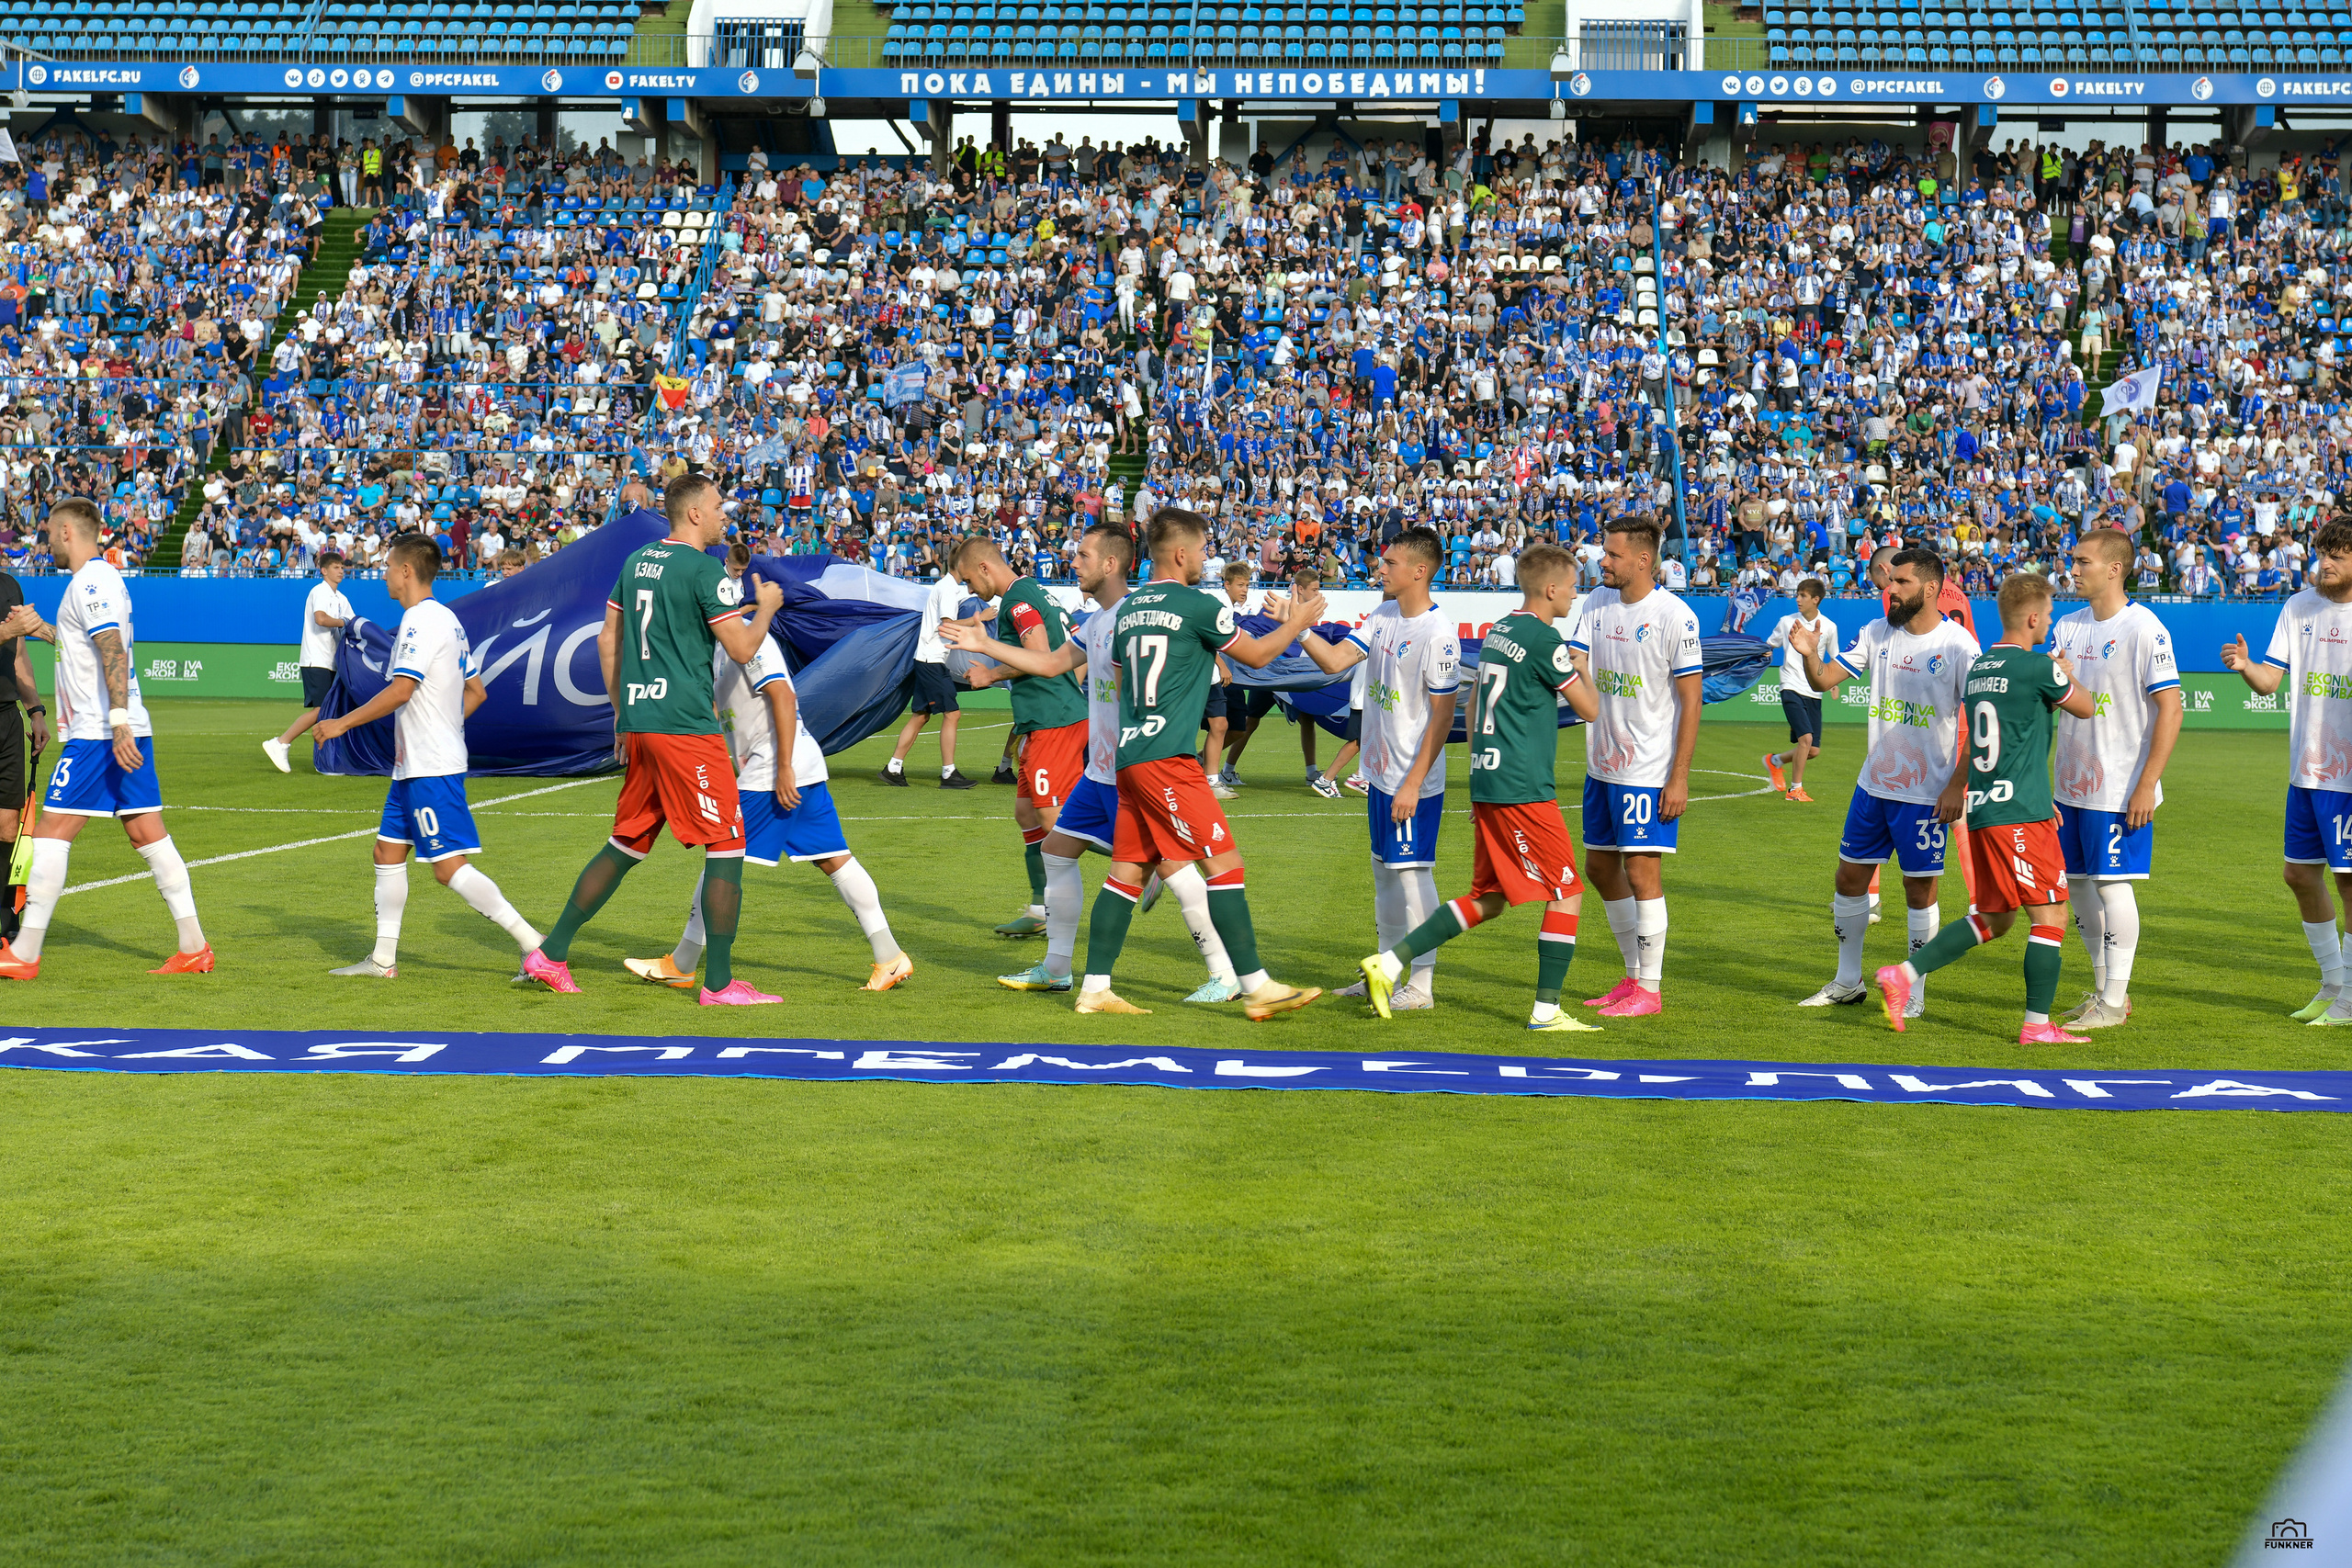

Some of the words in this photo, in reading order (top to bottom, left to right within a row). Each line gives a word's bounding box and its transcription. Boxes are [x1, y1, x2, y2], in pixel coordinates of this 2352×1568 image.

[53, 69, 141, 84] FAKELFC.RU
[410, 72, 500, 87] @PFCFAKEL
[629, 74, 696, 88] FAKELTV
[900, 73, 992, 94] ПОКА
[1010, 72, 1125, 97] ЕДИНЫ
[1166, 73, 1216, 94] МЫ
[1235, 69, 1486, 98] НЕПОБЕДИМЫ!
[1849, 79, 1945, 95] @PFCFAKEL
[2075, 81, 2145, 96] FAKELTV
[2283, 82, 2352, 96] FAKELFC
[636, 589, 654, 660] 7
[2320, 637, 2348, 645] OLIMPBET
[267, 671, 300, 680] ЭКОН
[1125, 635, 1169, 707] 17
[1597, 667, 1644, 688] EKONIVA
[1892, 662, 1921, 674] OLIMPBET
[1967, 675, 2009, 696] ПИНЯЕВ
[1869, 705, 1930, 728] ЭКОНИВА
[1880, 695, 1937, 717] EKONIVA
[1973, 700, 2001, 773] 9
[51, 757, 74, 787] 13
[1035, 768, 1050, 796] 6
[1623, 793, 1652, 825] 20
[413, 807, 440, 838] 10
[2333, 814, 2352, 845] 14
[1916, 818, 1945, 851] 33
[2108, 823, 2122, 854] 2
